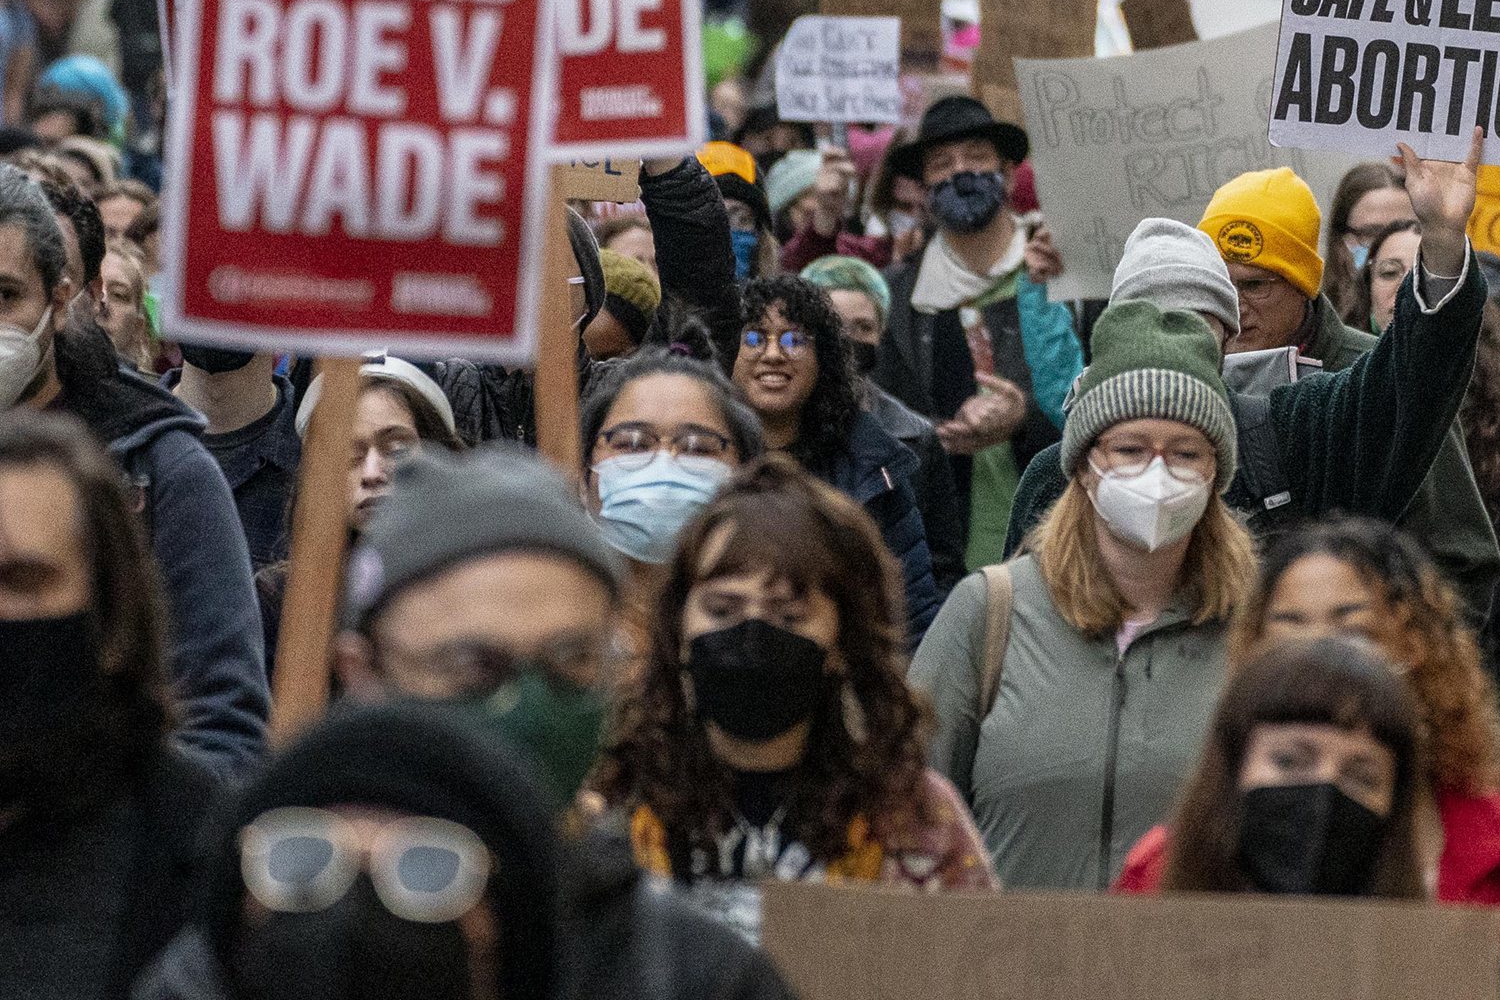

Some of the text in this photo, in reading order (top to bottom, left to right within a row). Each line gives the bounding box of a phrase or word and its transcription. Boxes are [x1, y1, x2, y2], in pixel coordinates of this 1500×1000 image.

[429, 4, 519, 124] V.
[1032, 64, 1226, 149] Protect
[211, 107, 512, 248] WADE
